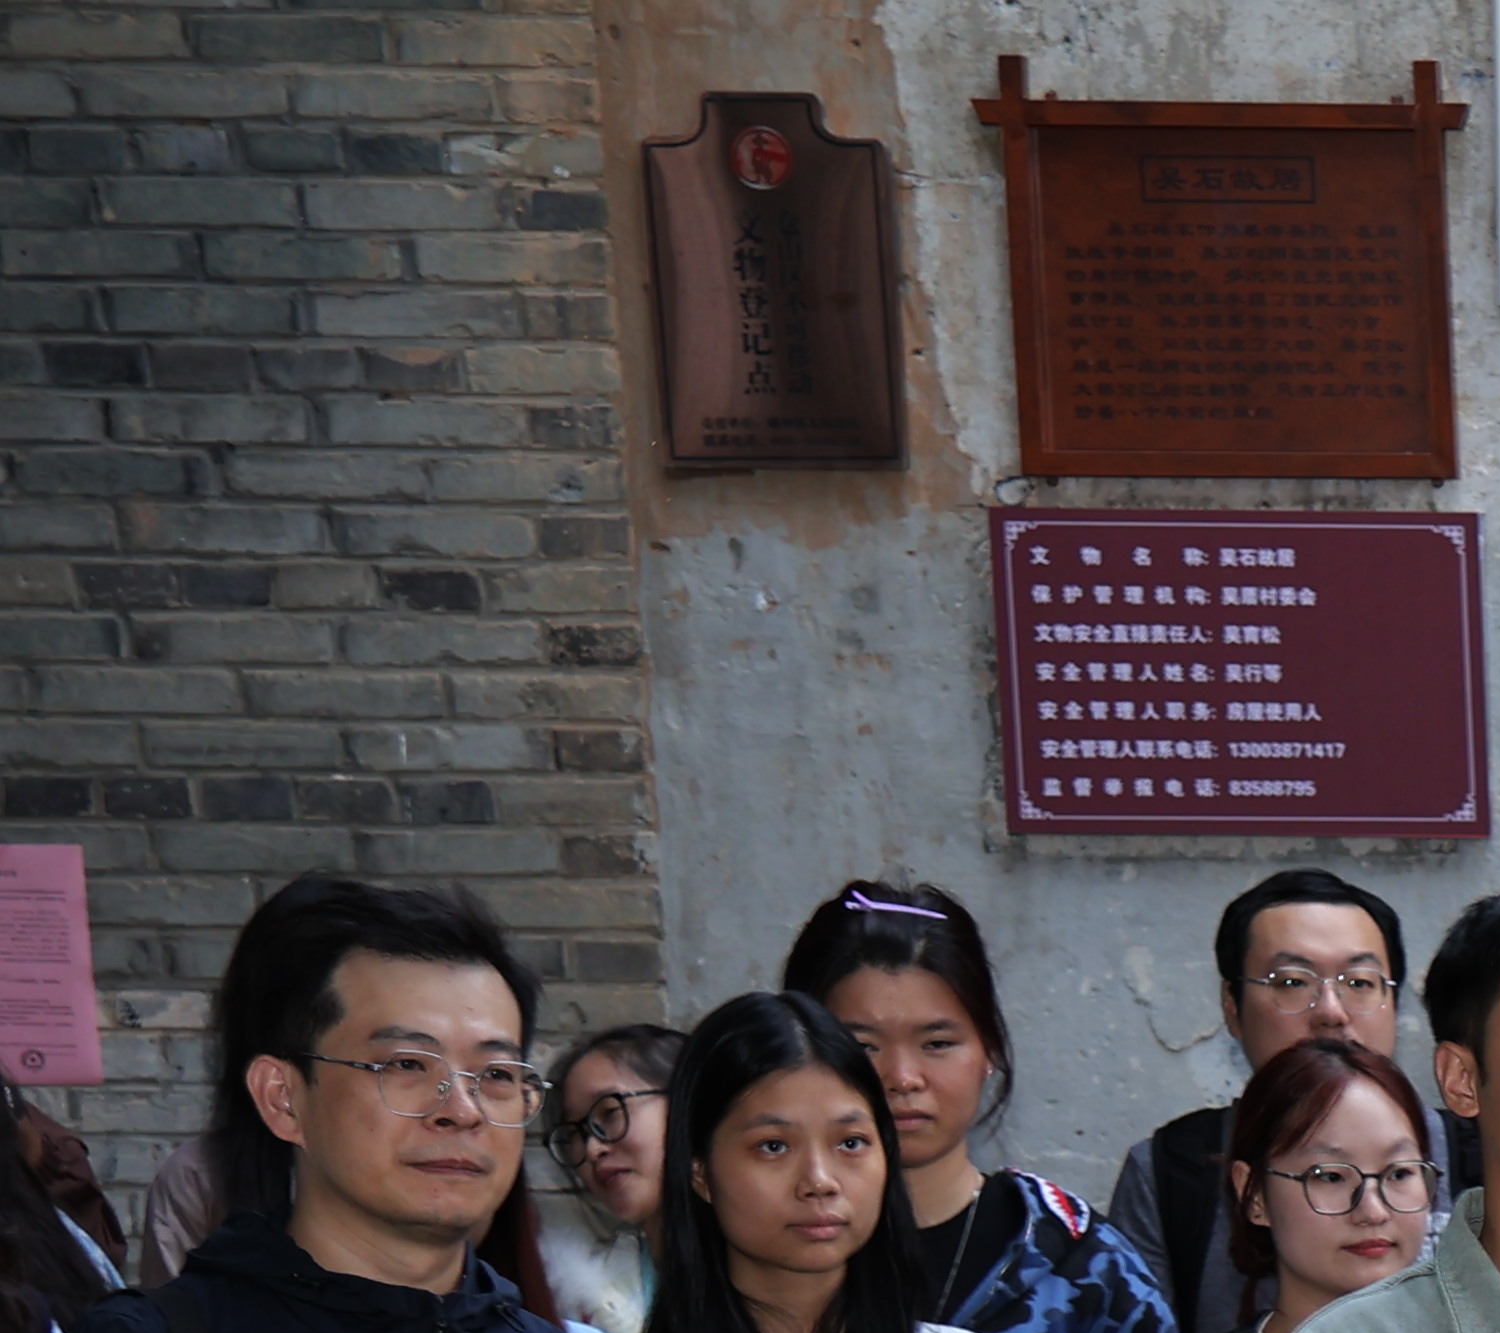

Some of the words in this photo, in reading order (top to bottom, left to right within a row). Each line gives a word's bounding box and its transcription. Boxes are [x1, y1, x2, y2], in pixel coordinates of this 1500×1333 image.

[1154, 167, 1303, 191] 吴石故居
[732, 208, 776, 396] 文物登记点
